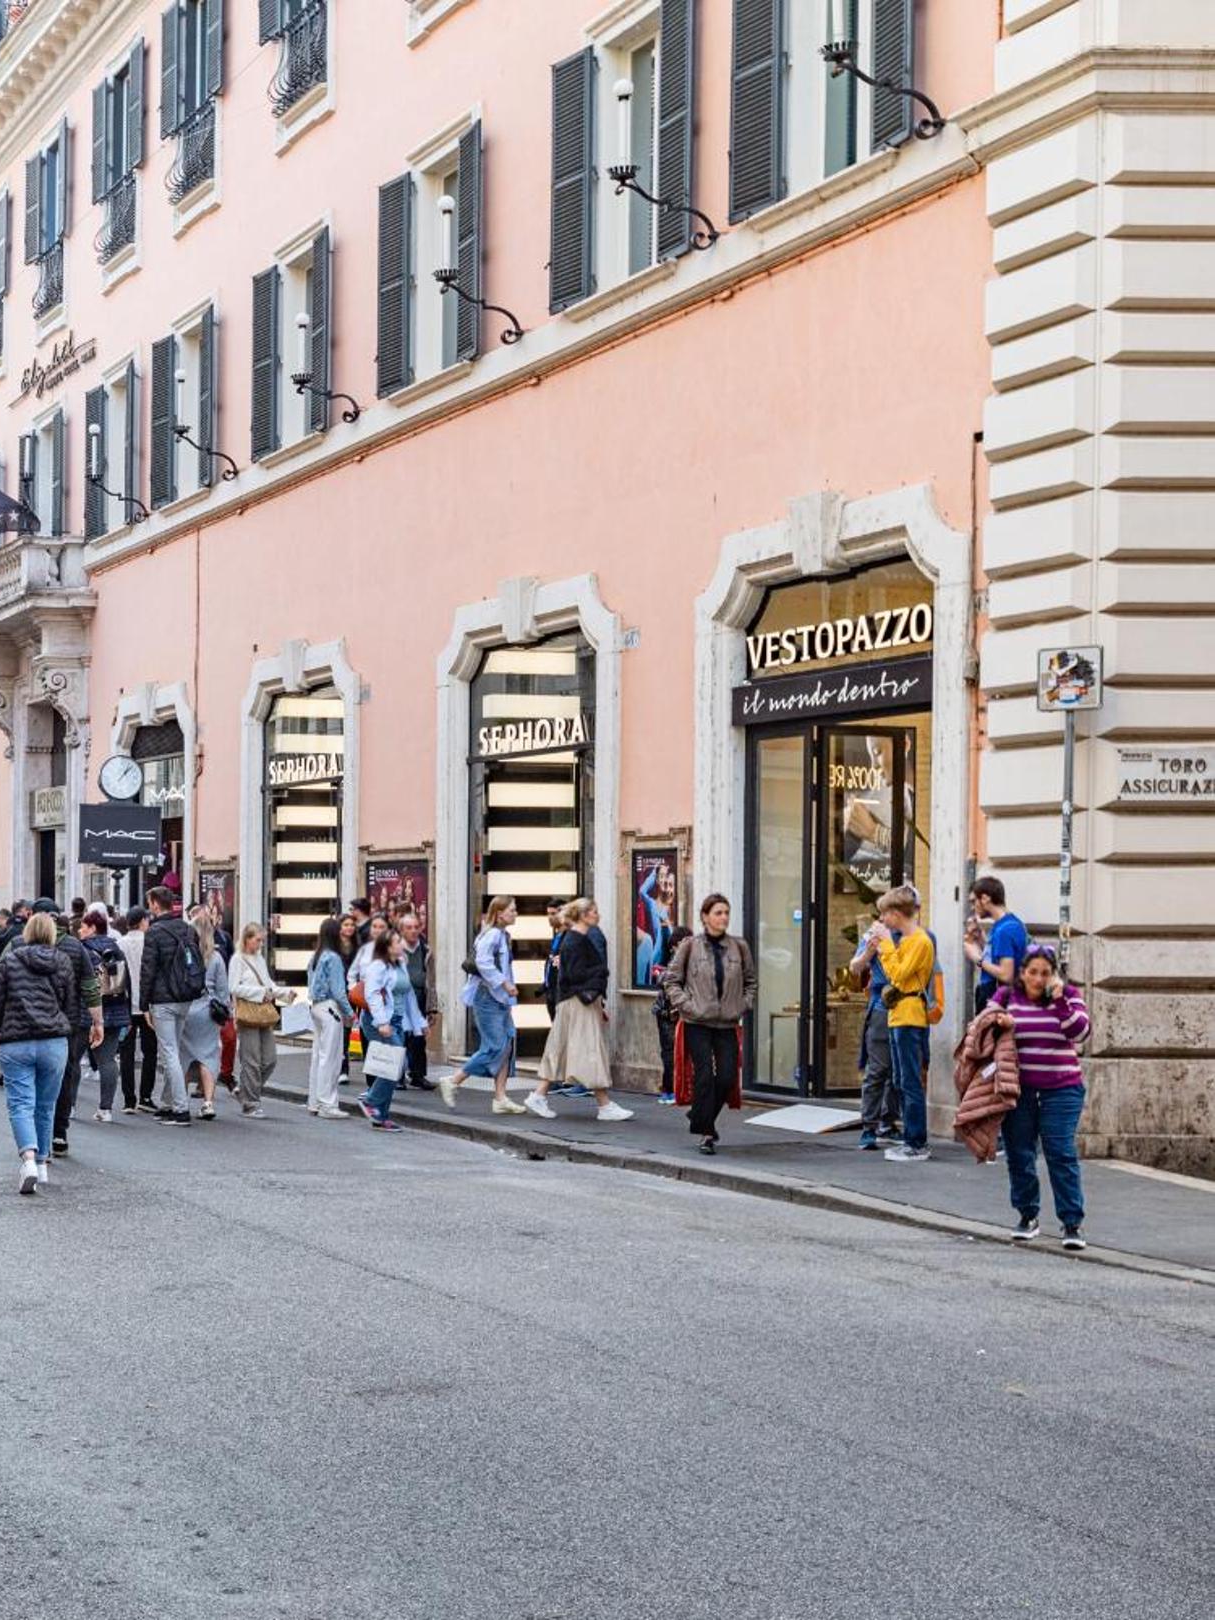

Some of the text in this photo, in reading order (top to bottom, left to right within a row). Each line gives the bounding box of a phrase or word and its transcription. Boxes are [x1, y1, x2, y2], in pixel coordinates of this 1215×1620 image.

[746, 603, 932, 669] VESTOPAZZO
[743, 670, 919, 714] il mondo dentro
[479, 715, 585, 755] SEPHORA
[269, 752, 340, 785] SEPHORA
[1158, 758, 1207, 774] TORO
[85, 829, 156, 840] MAC
